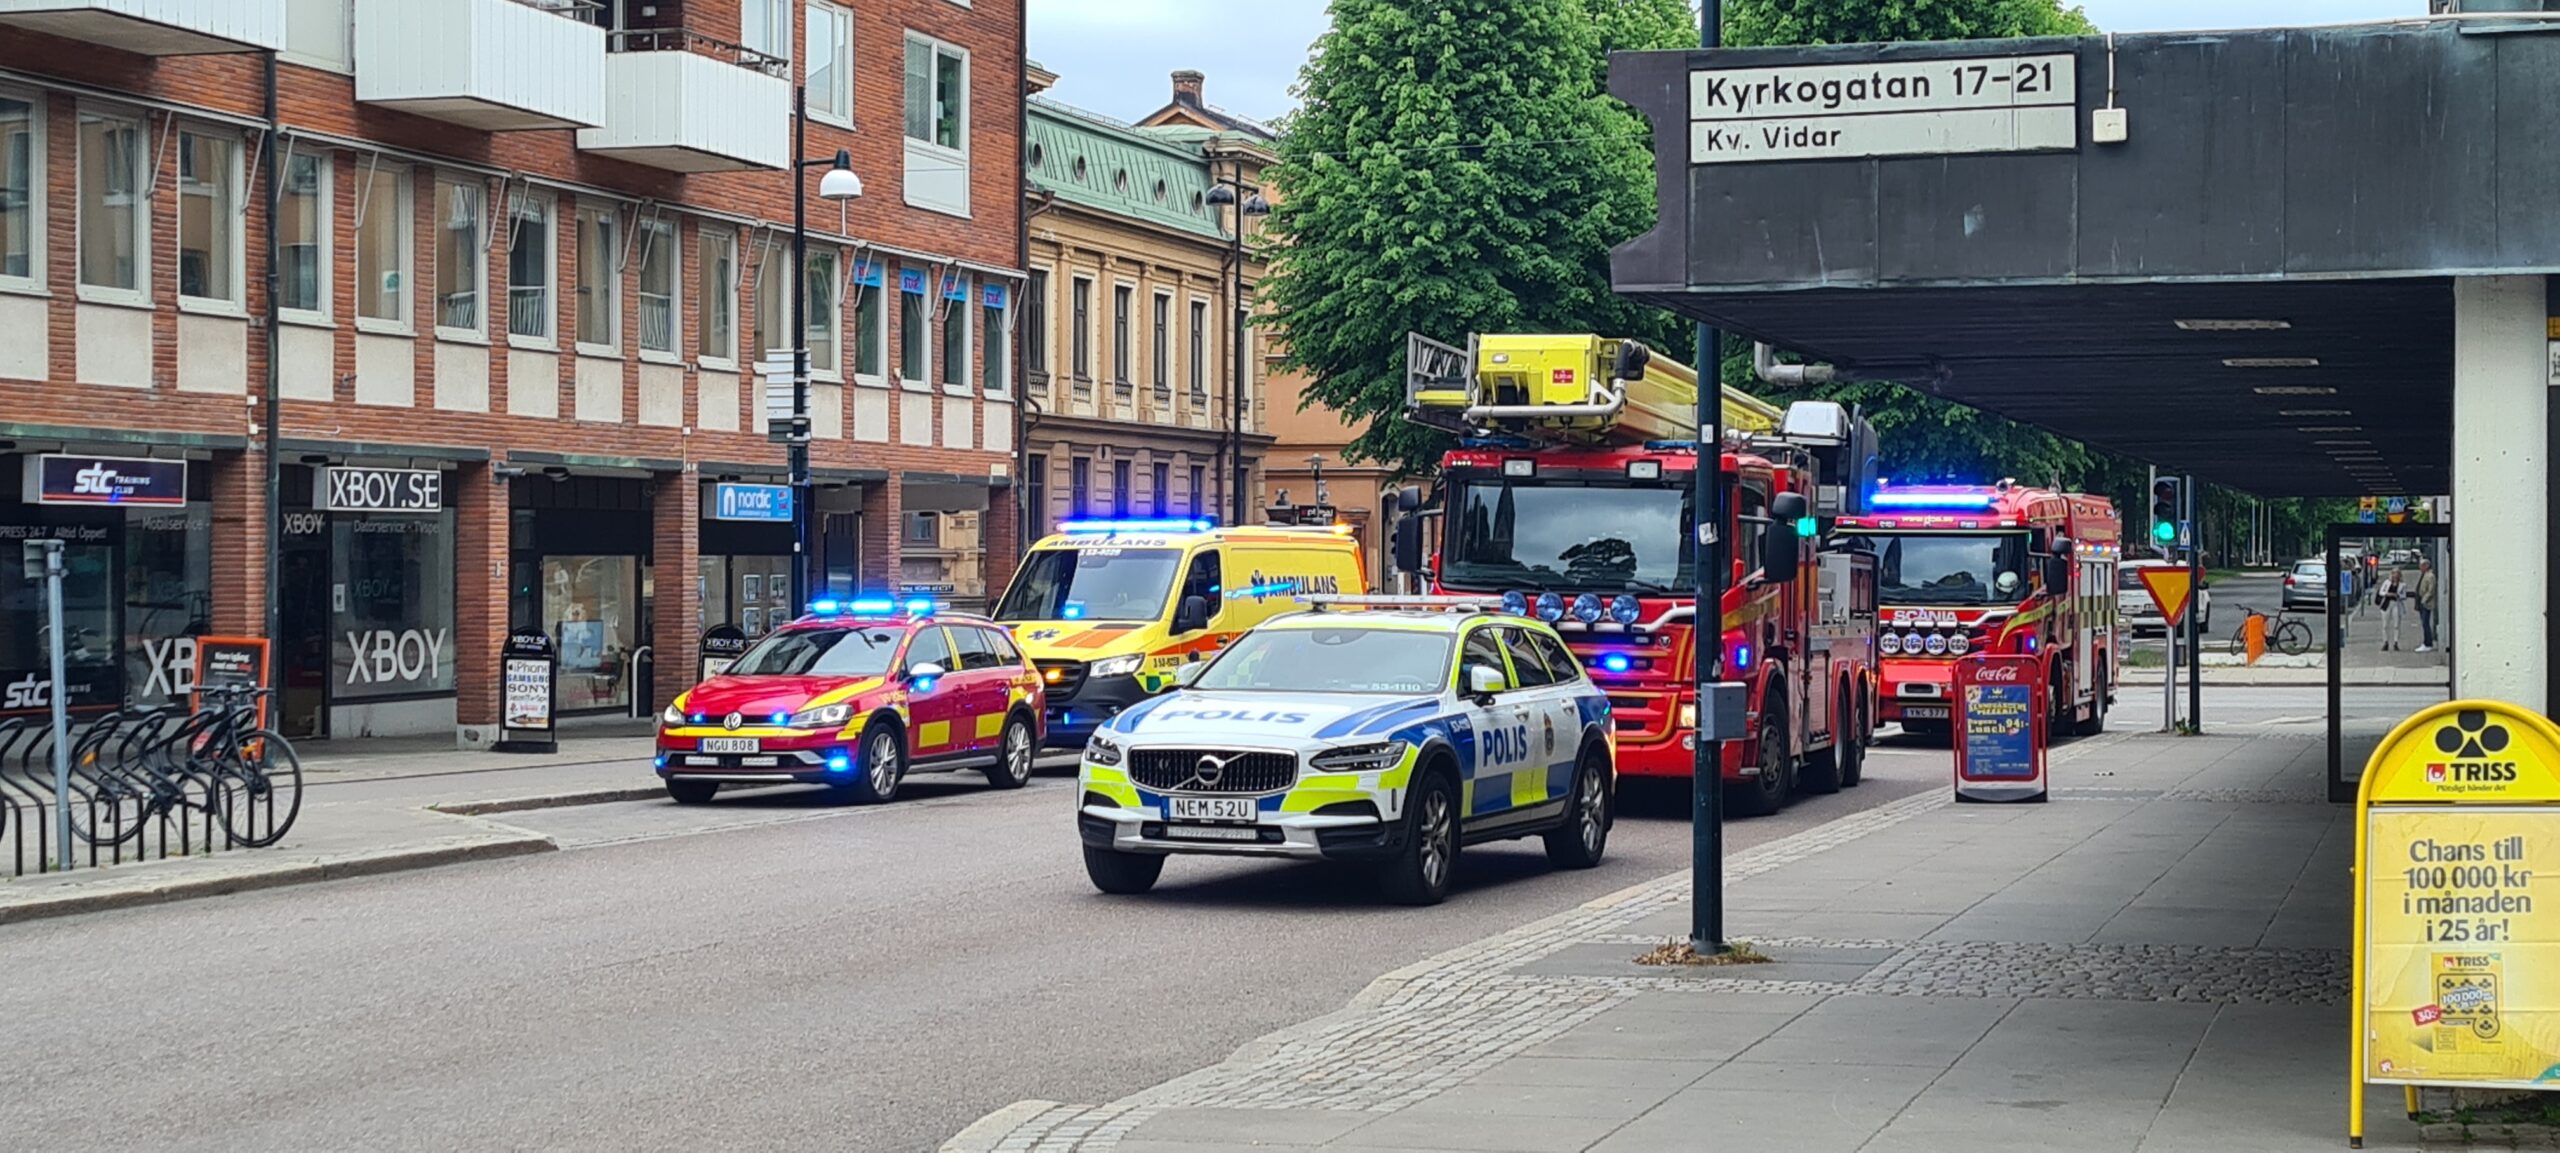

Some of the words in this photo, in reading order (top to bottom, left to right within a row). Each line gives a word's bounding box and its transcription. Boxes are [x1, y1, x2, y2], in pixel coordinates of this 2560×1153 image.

[1707, 72, 1930, 112] Kyrkogatan
[1953, 62, 2052, 96] 17-21
[1707, 128, 1750, 150] Kv.
[1763, 126, 1841, 149] Vidar
[114, 486, 134, 494] CLUB
[115, 475, 150, 485] TRAINING
[331, 471, 438, 508] XBOY.SE
[738, 489, 772, 508] nordic
[283, 513, 325, 534] XBOY
[1047, 538, 1167, 547] AMBULANS
[1270, 575, 1338, 597] AMBULANS
[1893, 610, 1957, 623] SCANIA
[347, 629, 446, 684] XBOY
[142, 638, 197, 697] XB
[508, 684, 549, 693] SONY
[1371, 682, 1421, 691] 53-1110
[1163, 709, 1311, 725] POLIS
[1968, 722, 2006, 734] Lunch
[707, 739, 727, 752] NGU
[732, 739, 754, 752] 808
[1482, 724, 1527, 767] POLIS
[2450, 762, 2517, 781] TRISS
[1175, 797, 1209, 817] NEM
[1214, 796, 1248, 817] 52U
[2409, 838, 2485, 862] Chans
[2493, 836, 2523, 860] till
[2403, 867, 2447, 889] 100
[2451, 866, 2498, 888] 000
[2503, 864, 2532, 887] kr
[2403, 892, 2411, 914] i
[2416, 889, 2532, 914] månaden
[2426, 919, 2433, 942] i
[2438, 919, 2470, 941] 25
[2475, 918, 2509, 941] år!
[2456, 956, 2490, 967] TRISS
